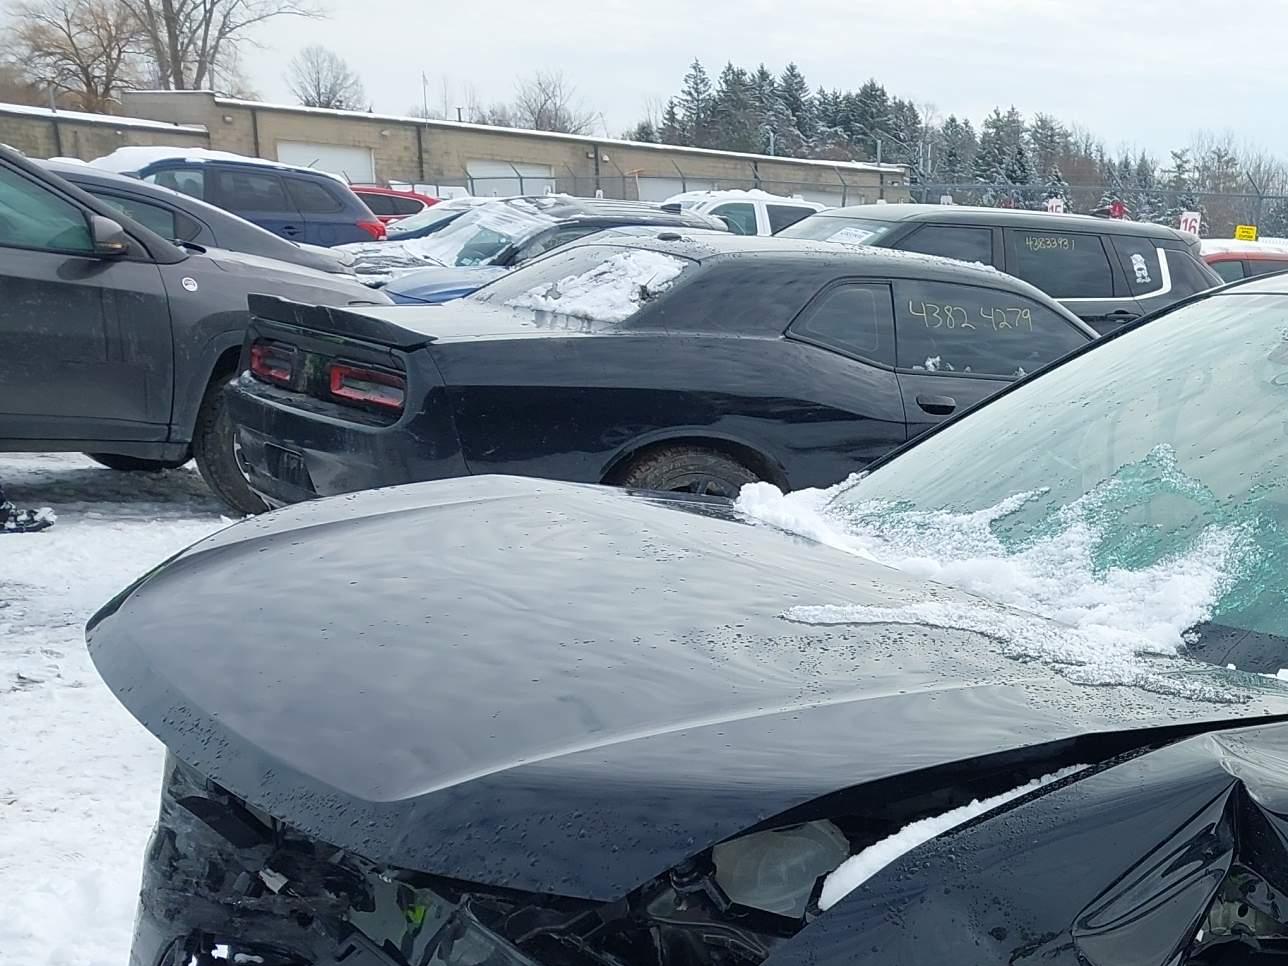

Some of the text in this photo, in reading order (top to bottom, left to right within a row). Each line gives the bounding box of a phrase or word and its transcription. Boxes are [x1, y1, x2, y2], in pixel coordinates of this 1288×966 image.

[1182, 217, 1198, 234] 16
[909, 300, 1033, 332] 4382 4279
